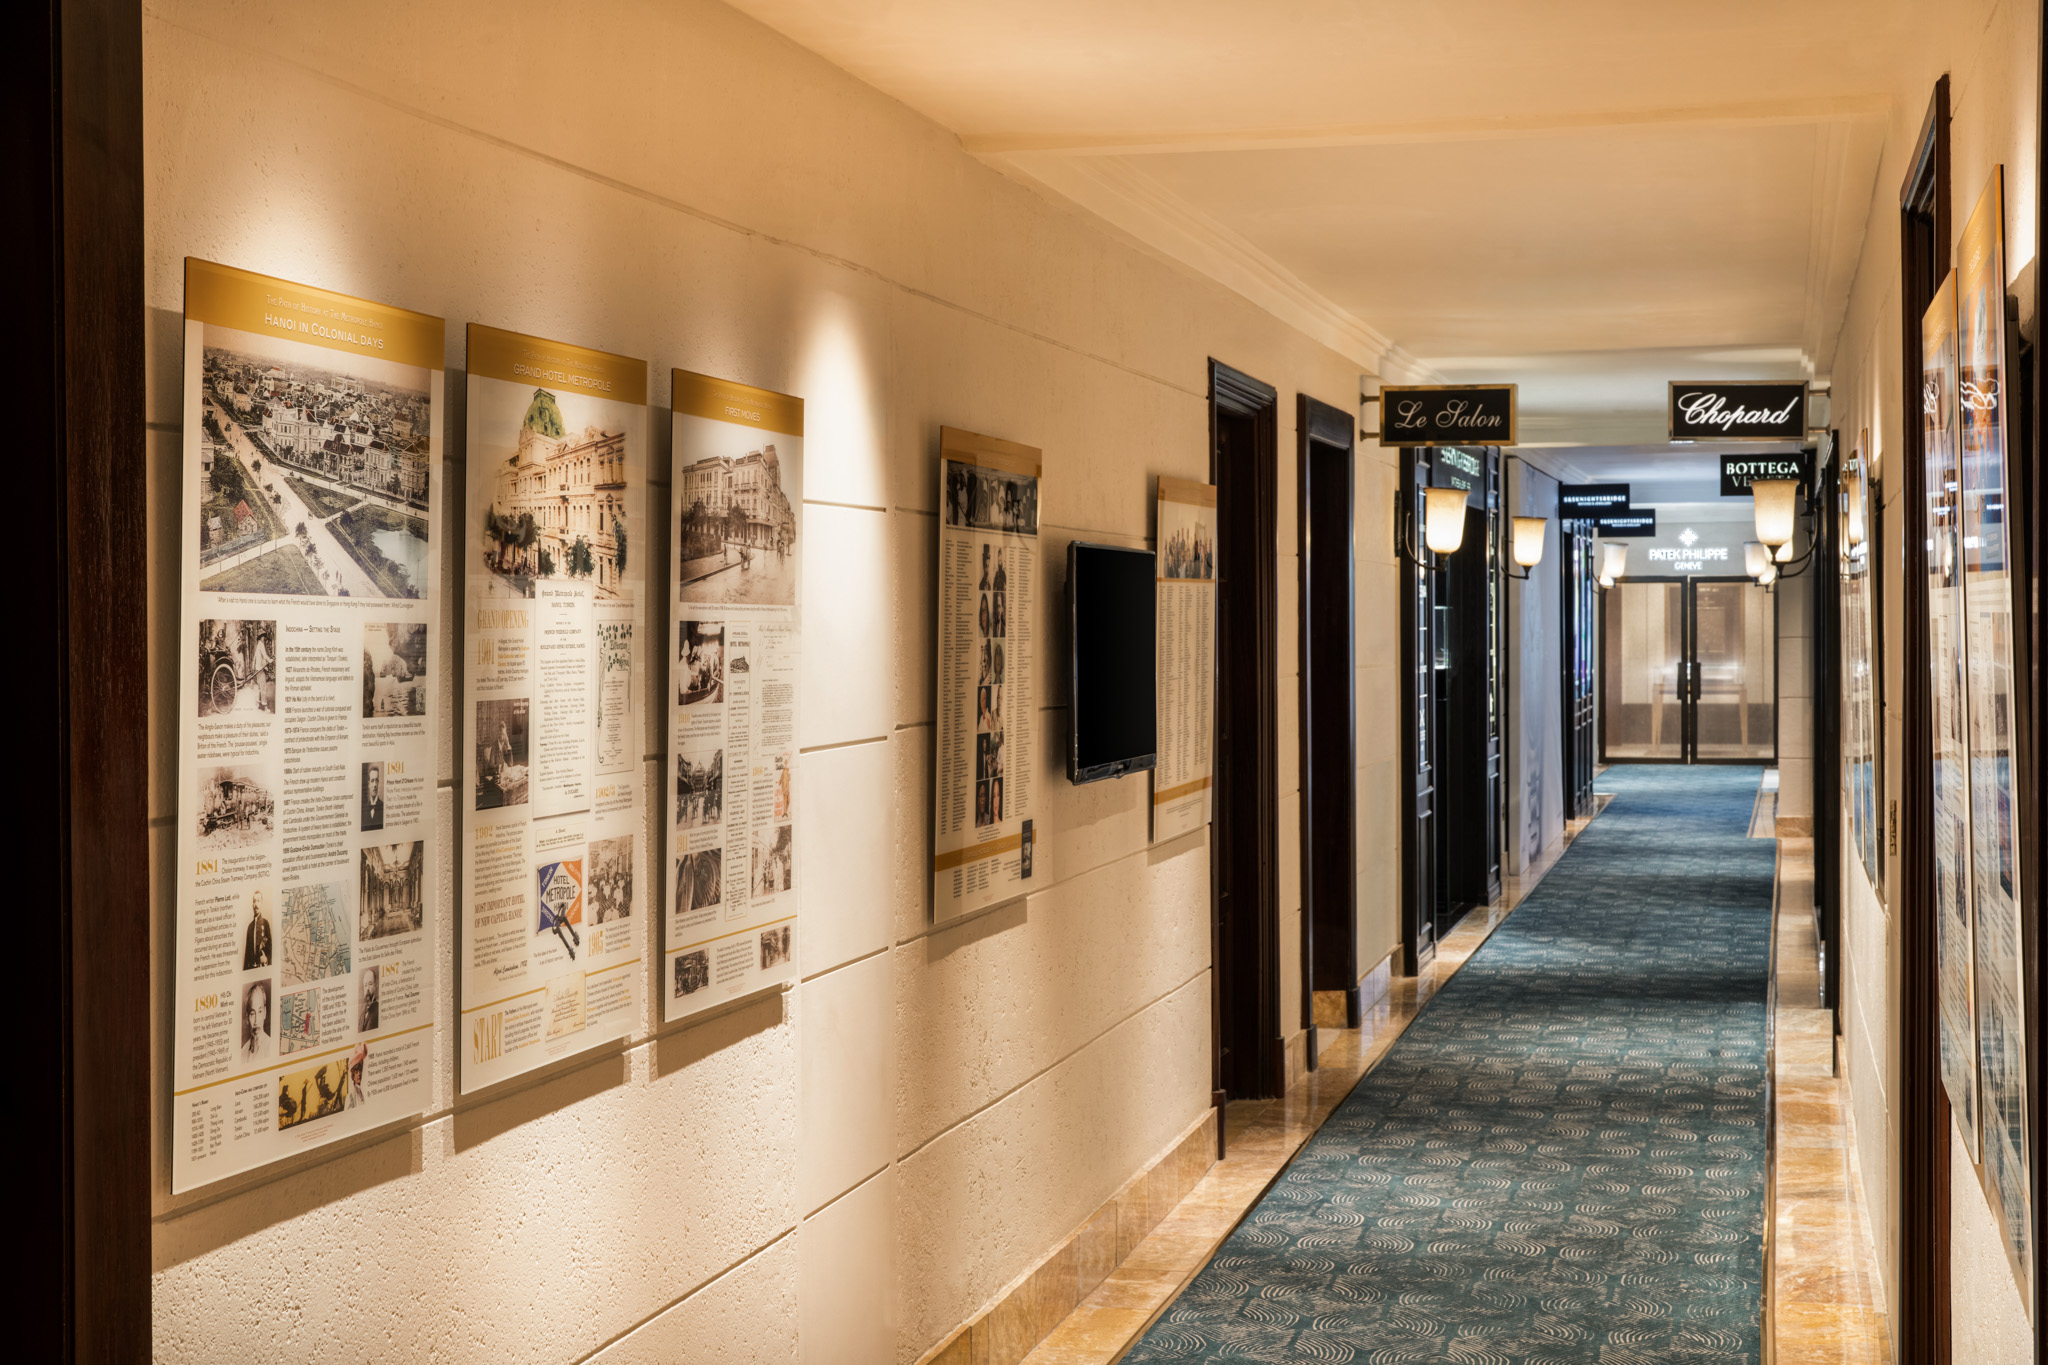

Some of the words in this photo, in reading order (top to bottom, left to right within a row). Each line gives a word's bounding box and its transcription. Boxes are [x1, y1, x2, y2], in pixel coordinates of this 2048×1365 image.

[264, 312, 296, 330] HANOI
[299, 322, 309, 333] IN
[312, 323, 358, 345] COLONIAL
[360, 335, 384, 350] DAYS
[513, 364, 542, 378] GRAND
[543, 370, 567, 384] HOTEL
[568, 375, 611, 392] METROPOLE
[725, 406, 740, 417] FIRST
[741, 409, 760, 422] MOVES
[1394, 400, 1428, 428] Le
[1435, 399, 1502, 428] Salon
[1678, 392, 1799, 431] Chopard
[1726, 462, 1799, 475] BOTTEGA
[1649, 548, 1681, 560] PATEK
[1682, 548, 1728, 560] PHILIPPE
[478, 609, 500, 630] GRAND
[500, 609, 529, 629] OPENING
[477, 638, 495, 665] 1901
[386, 760, 405, 775] 1891
[475, 824, 493, 840] 1902
[676, 834, 688, 852] 1911
[196, 858, 218, 876] 1881
[554, 875, 570, 885] HOTEL
[546, 886, 575, 904] METROPOLE
[554, 902, 569, 912] HAI
[588, 931, 604, 958] 1905
[381, 961, 400, 978] 1887
[194, 993, 218, 1013] 1890
[473, 1012, 503, 1065] START
